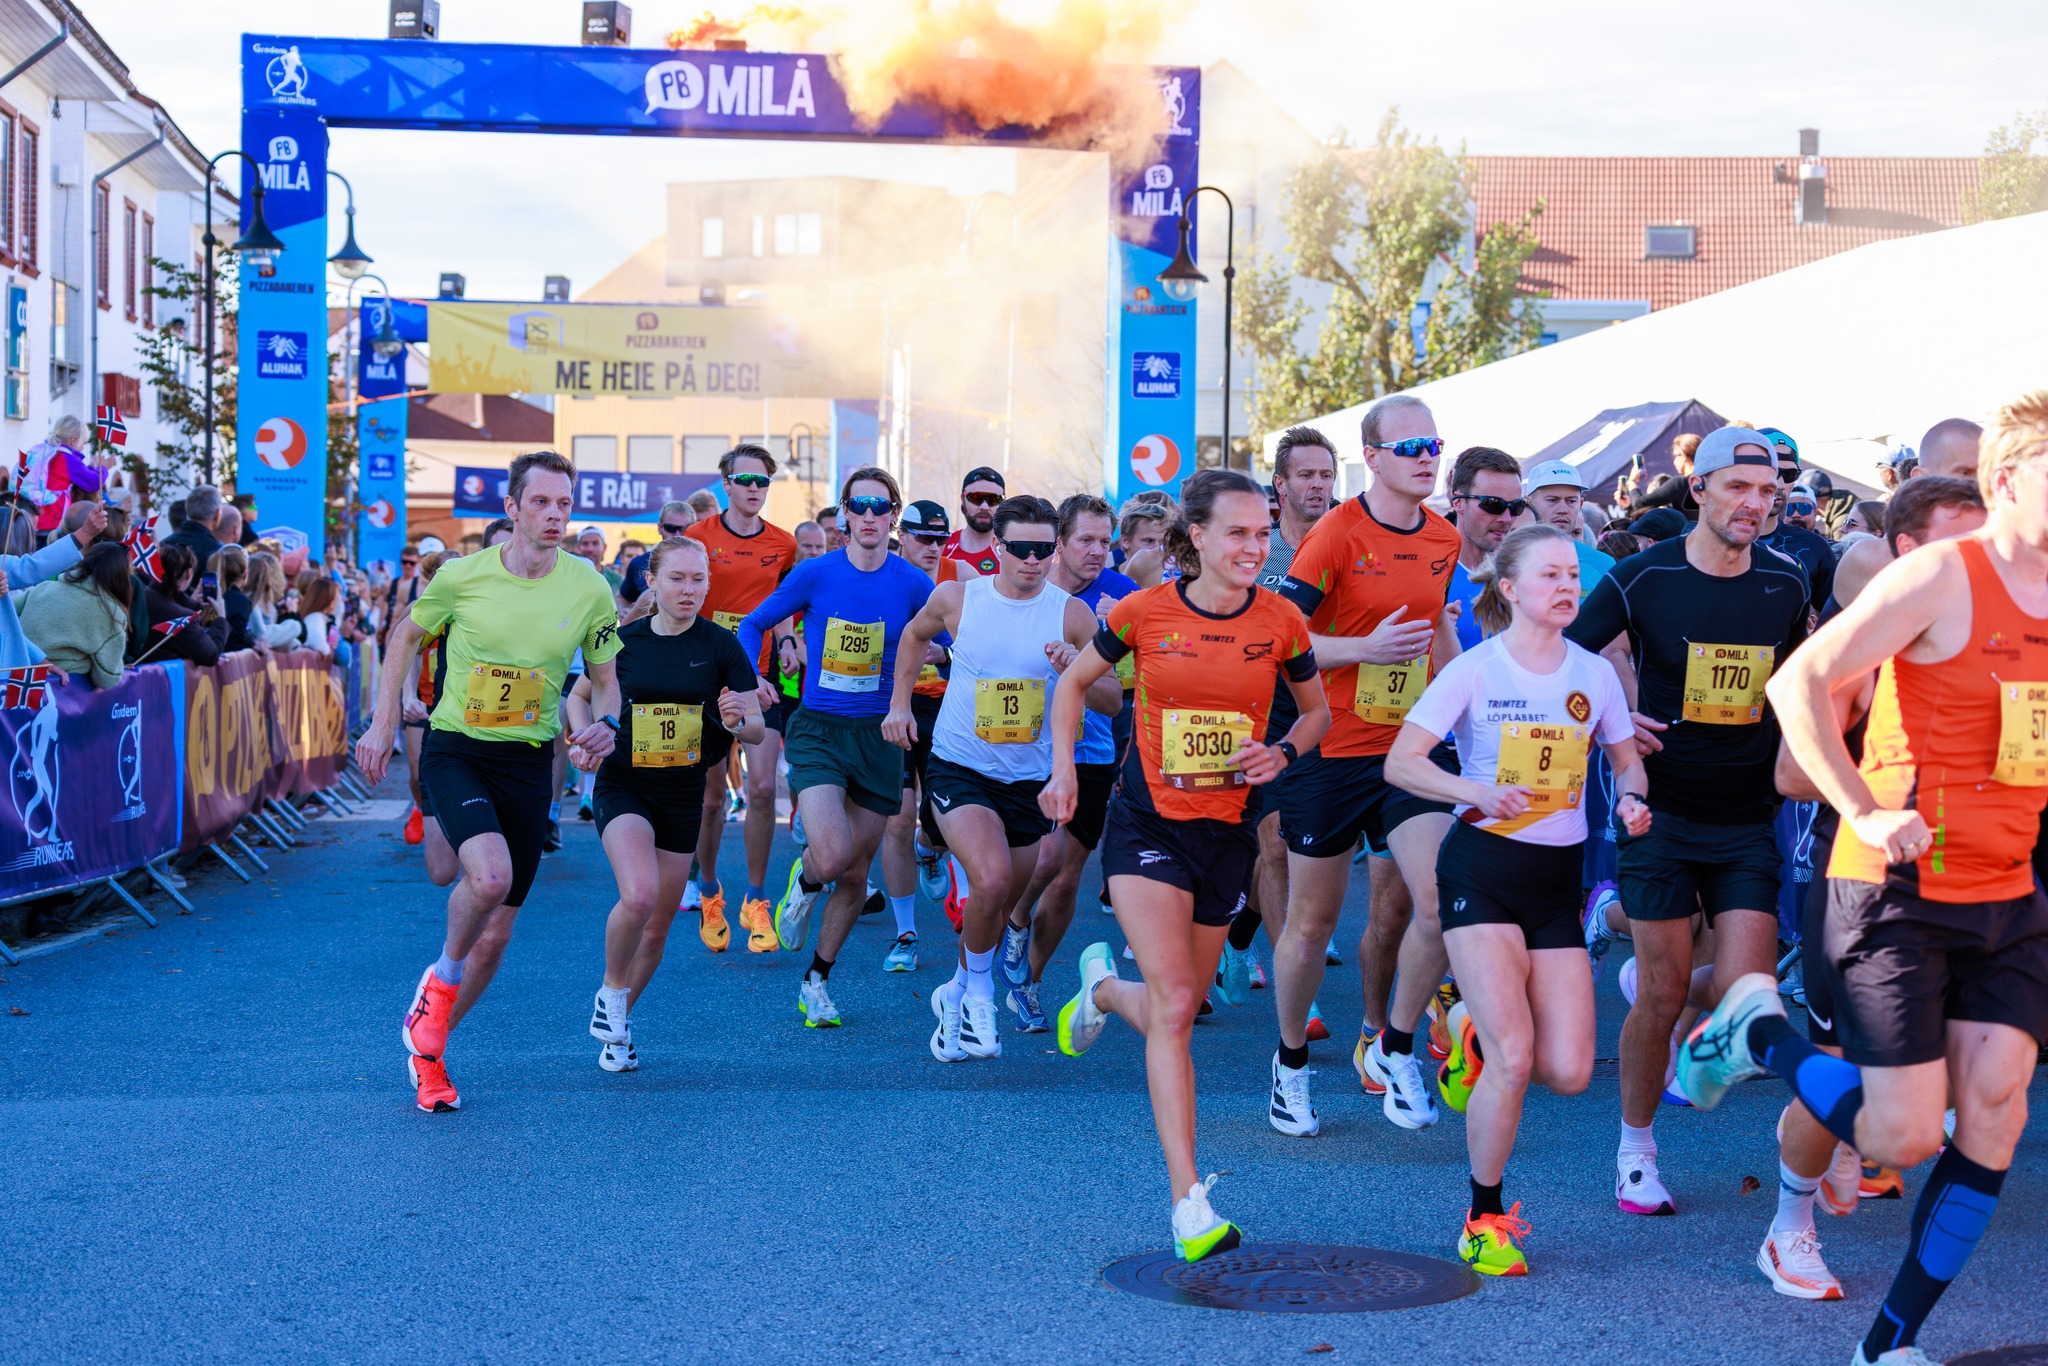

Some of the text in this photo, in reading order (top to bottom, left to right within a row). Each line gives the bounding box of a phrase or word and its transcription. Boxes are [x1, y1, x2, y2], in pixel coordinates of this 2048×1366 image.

[660, 58, 816, 118] PB MILÅ
[275, 140, 291, 156] PB
[257, 161, 311, 191] MILÅ
[1132, 187, 1183, 217] MILÅ
[249, 281, 314, 293] PIZZABAKEREN
[625, 335, 707, 349] PIZZABAKEREN
[261, 362, 303, 375] ALUHAK
[555, 354, 761, 392] ME HEIE PÅ DEG!
[1137, 382, 1177, 394] ALUHAK
[601, 472, 648, 510] RÅ!!
[852, 625, 868, 634] MILÅ
[840, 634, 870, 653] 1295
[1200, 634, 1236, 643] TRIMTEX
[1727, 649, 1749, 661] MILÅ
[501, 670, 521, 680] MILÅ
[1387, 671, 1408, 694] 37
[1711, 665, 1751, 690] 1170
[499, 683, 512, 702] 2
[1006, 681, 1024, 691] MILÅ
[662, 706, 680, 716] MILÅ
[1002, 695, 1019, 715] 13
[1488, 700, 1528, 708] TRIMTEX
[1203, 714, 1226, 726] MILÅ
[2032, 709, 2047, 740] 57
[660, 719, 676, 740] 18
[1542, 728, 1564, 741] MILÅ
[1183, 730, 1232, 758] 3030
[1199, 762, 1219, 770] KRISTIN
[1538, 746, 1553, 772] 8
[1194, 777, 1224, 787] DOBBELEN
[34, 841, 74, 866] RUNNERS
